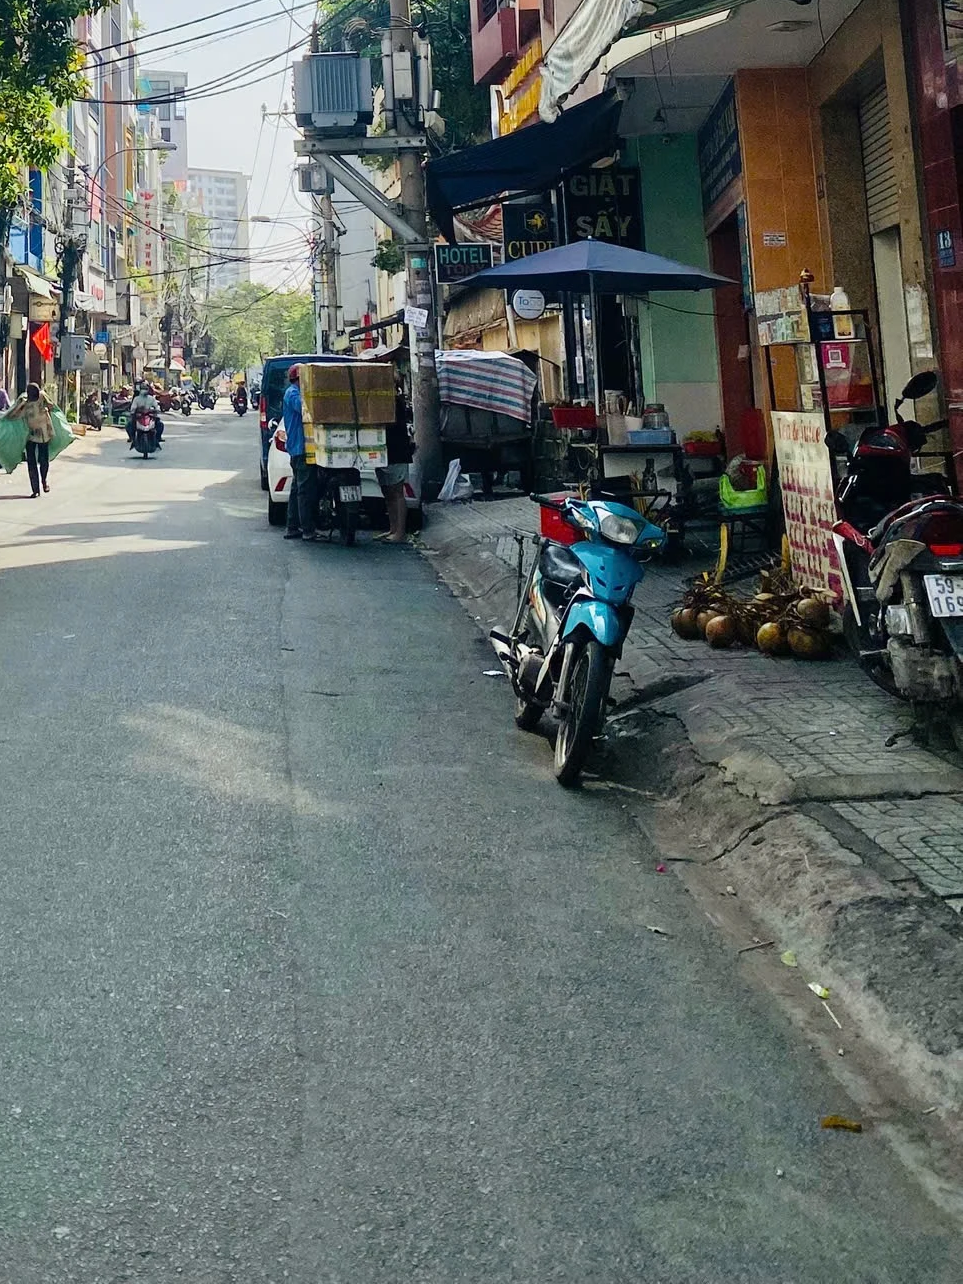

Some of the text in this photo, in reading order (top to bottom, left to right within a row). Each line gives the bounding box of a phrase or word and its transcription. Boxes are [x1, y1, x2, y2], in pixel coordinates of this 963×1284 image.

[570, 170, 635, 202] GIẶT
[576, 207, 632, 238] SẤY
[439, 247, 488, 264] HOTEL
